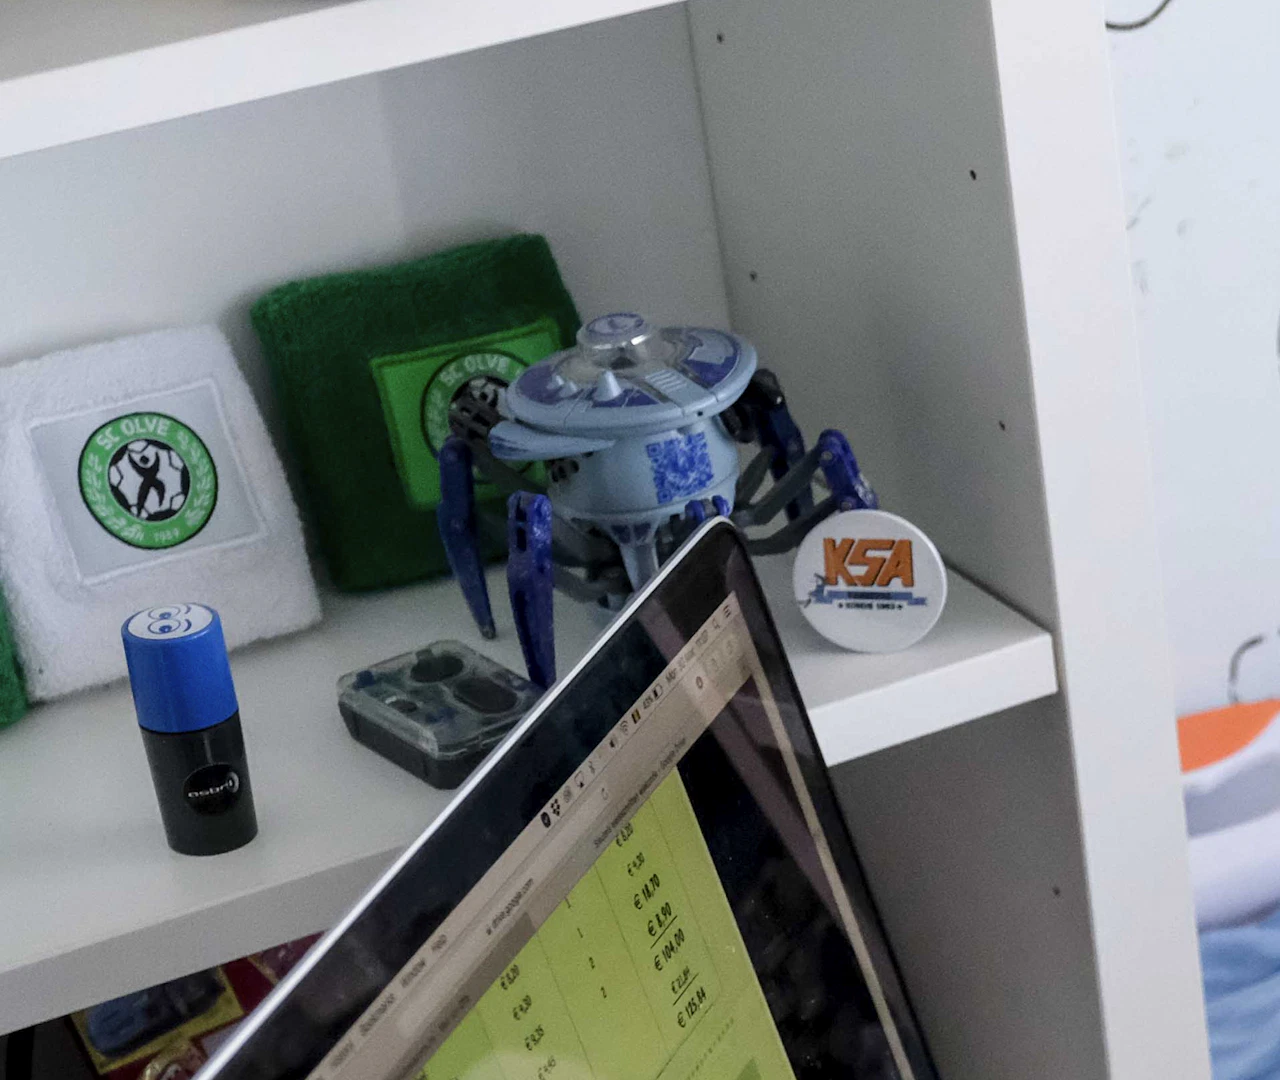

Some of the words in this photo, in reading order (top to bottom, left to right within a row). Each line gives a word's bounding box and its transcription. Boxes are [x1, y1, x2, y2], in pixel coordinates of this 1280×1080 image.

[96, 428, 120, 450] SC
[120, 416, 170, 437] OLVE
[823, 538, 915, 588] KSA
